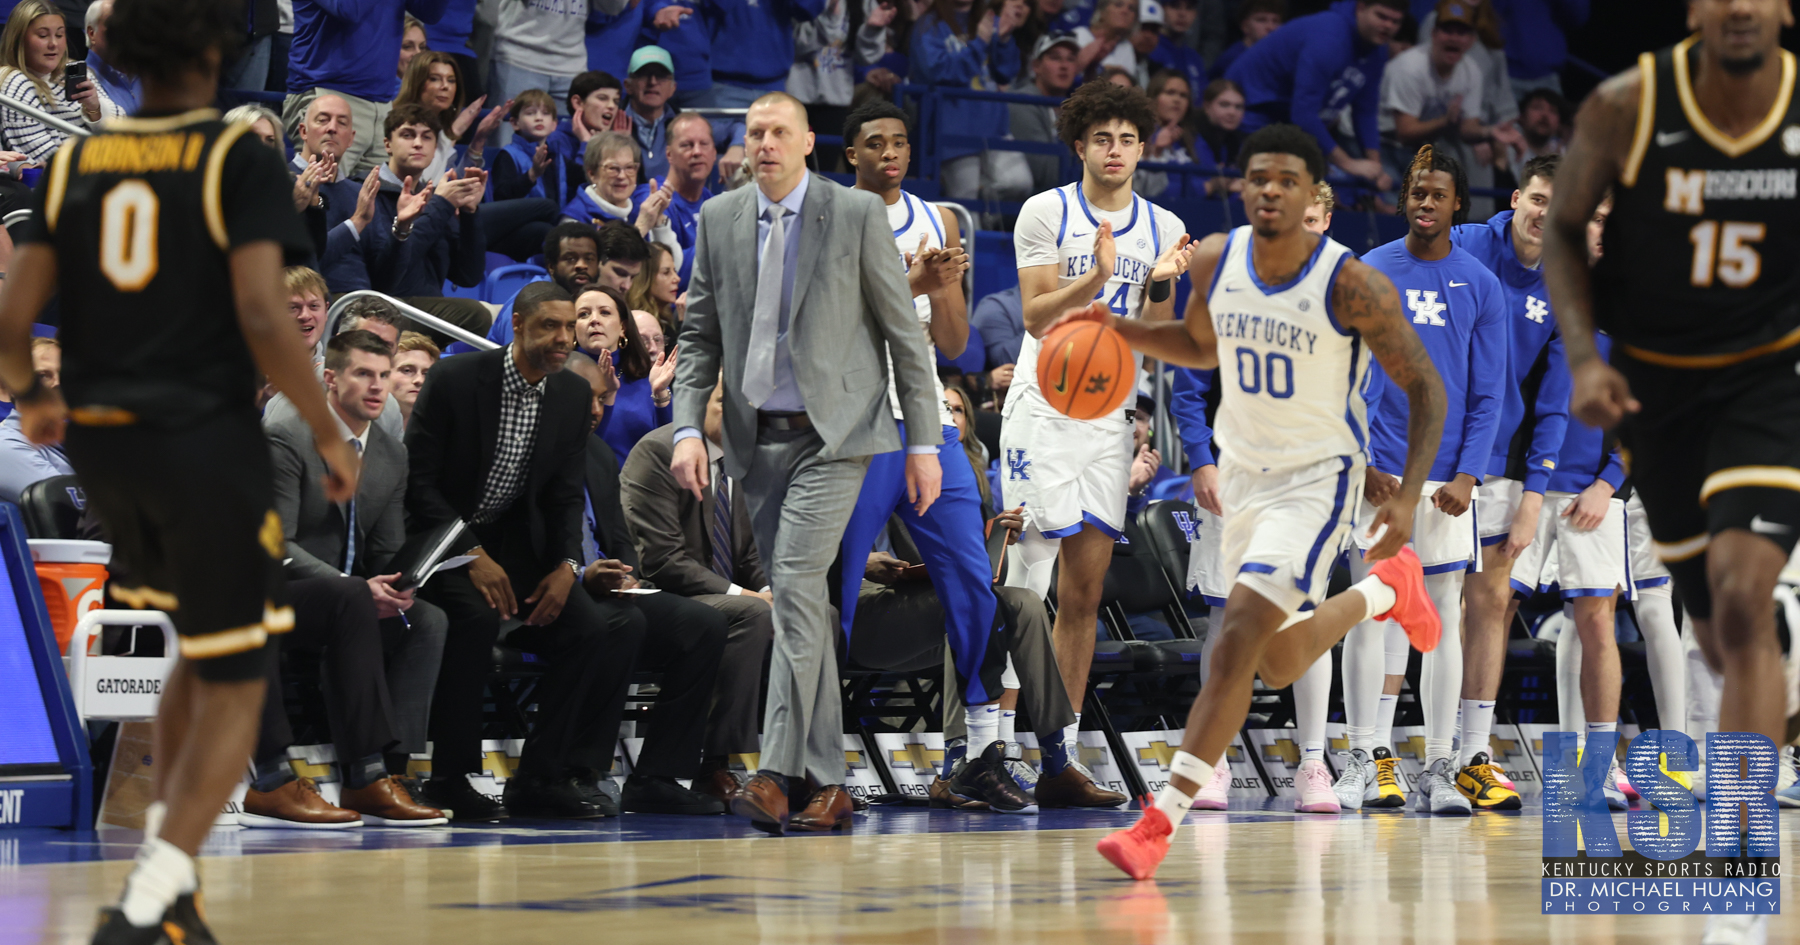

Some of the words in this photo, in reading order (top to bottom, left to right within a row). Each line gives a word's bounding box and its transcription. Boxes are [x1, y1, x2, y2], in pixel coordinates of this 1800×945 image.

[1664, 166, 1797, 215] MISSOURI
[99, 178, 160, 292] 0
[1689, 219, 1766, 288] 15
[1066, 253, 1150, 285] KENUCKY
[1405, 289, 1447, 327] UK
[1524, 295, 1549, 324] UK
[1216, 312, 1317, 355] KENTUCKY
[1235, 346, 1294, 399] 00
[1006, 448, 1032, 481] UK
[96, 678, 161, 695] GATORADE
